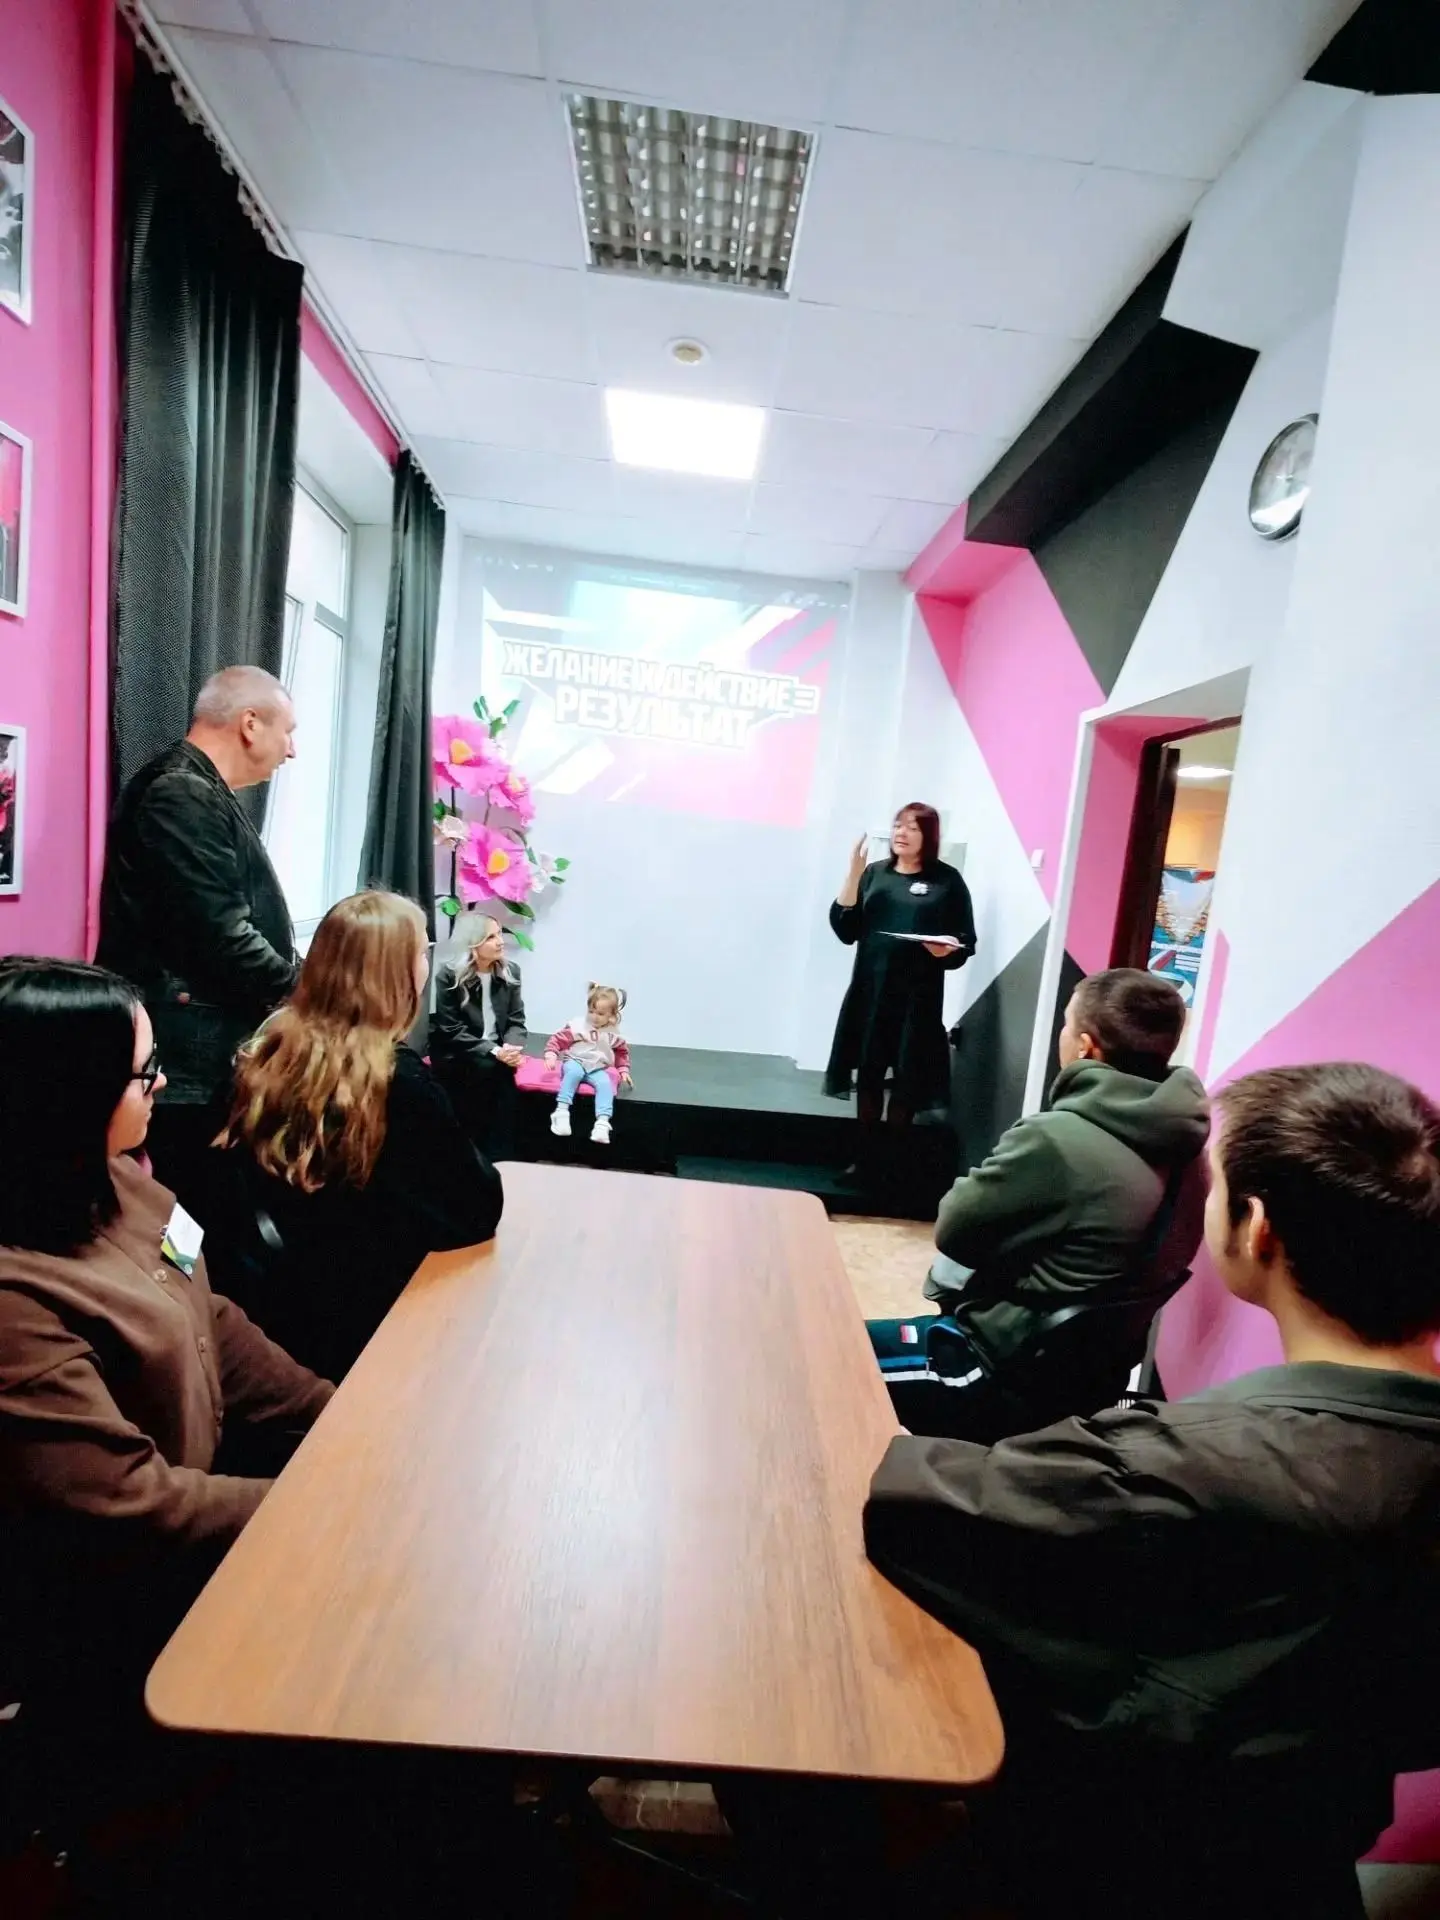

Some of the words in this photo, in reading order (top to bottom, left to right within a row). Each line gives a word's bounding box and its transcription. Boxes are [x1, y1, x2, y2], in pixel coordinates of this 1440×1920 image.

[503, 642, 633, 690] ЖЕЛАНИЕ
[660, 662, 791, 713] ДЕЙСТВИЕ
[555, 685, 752, 748] РЕЗУЛЬТАТ
